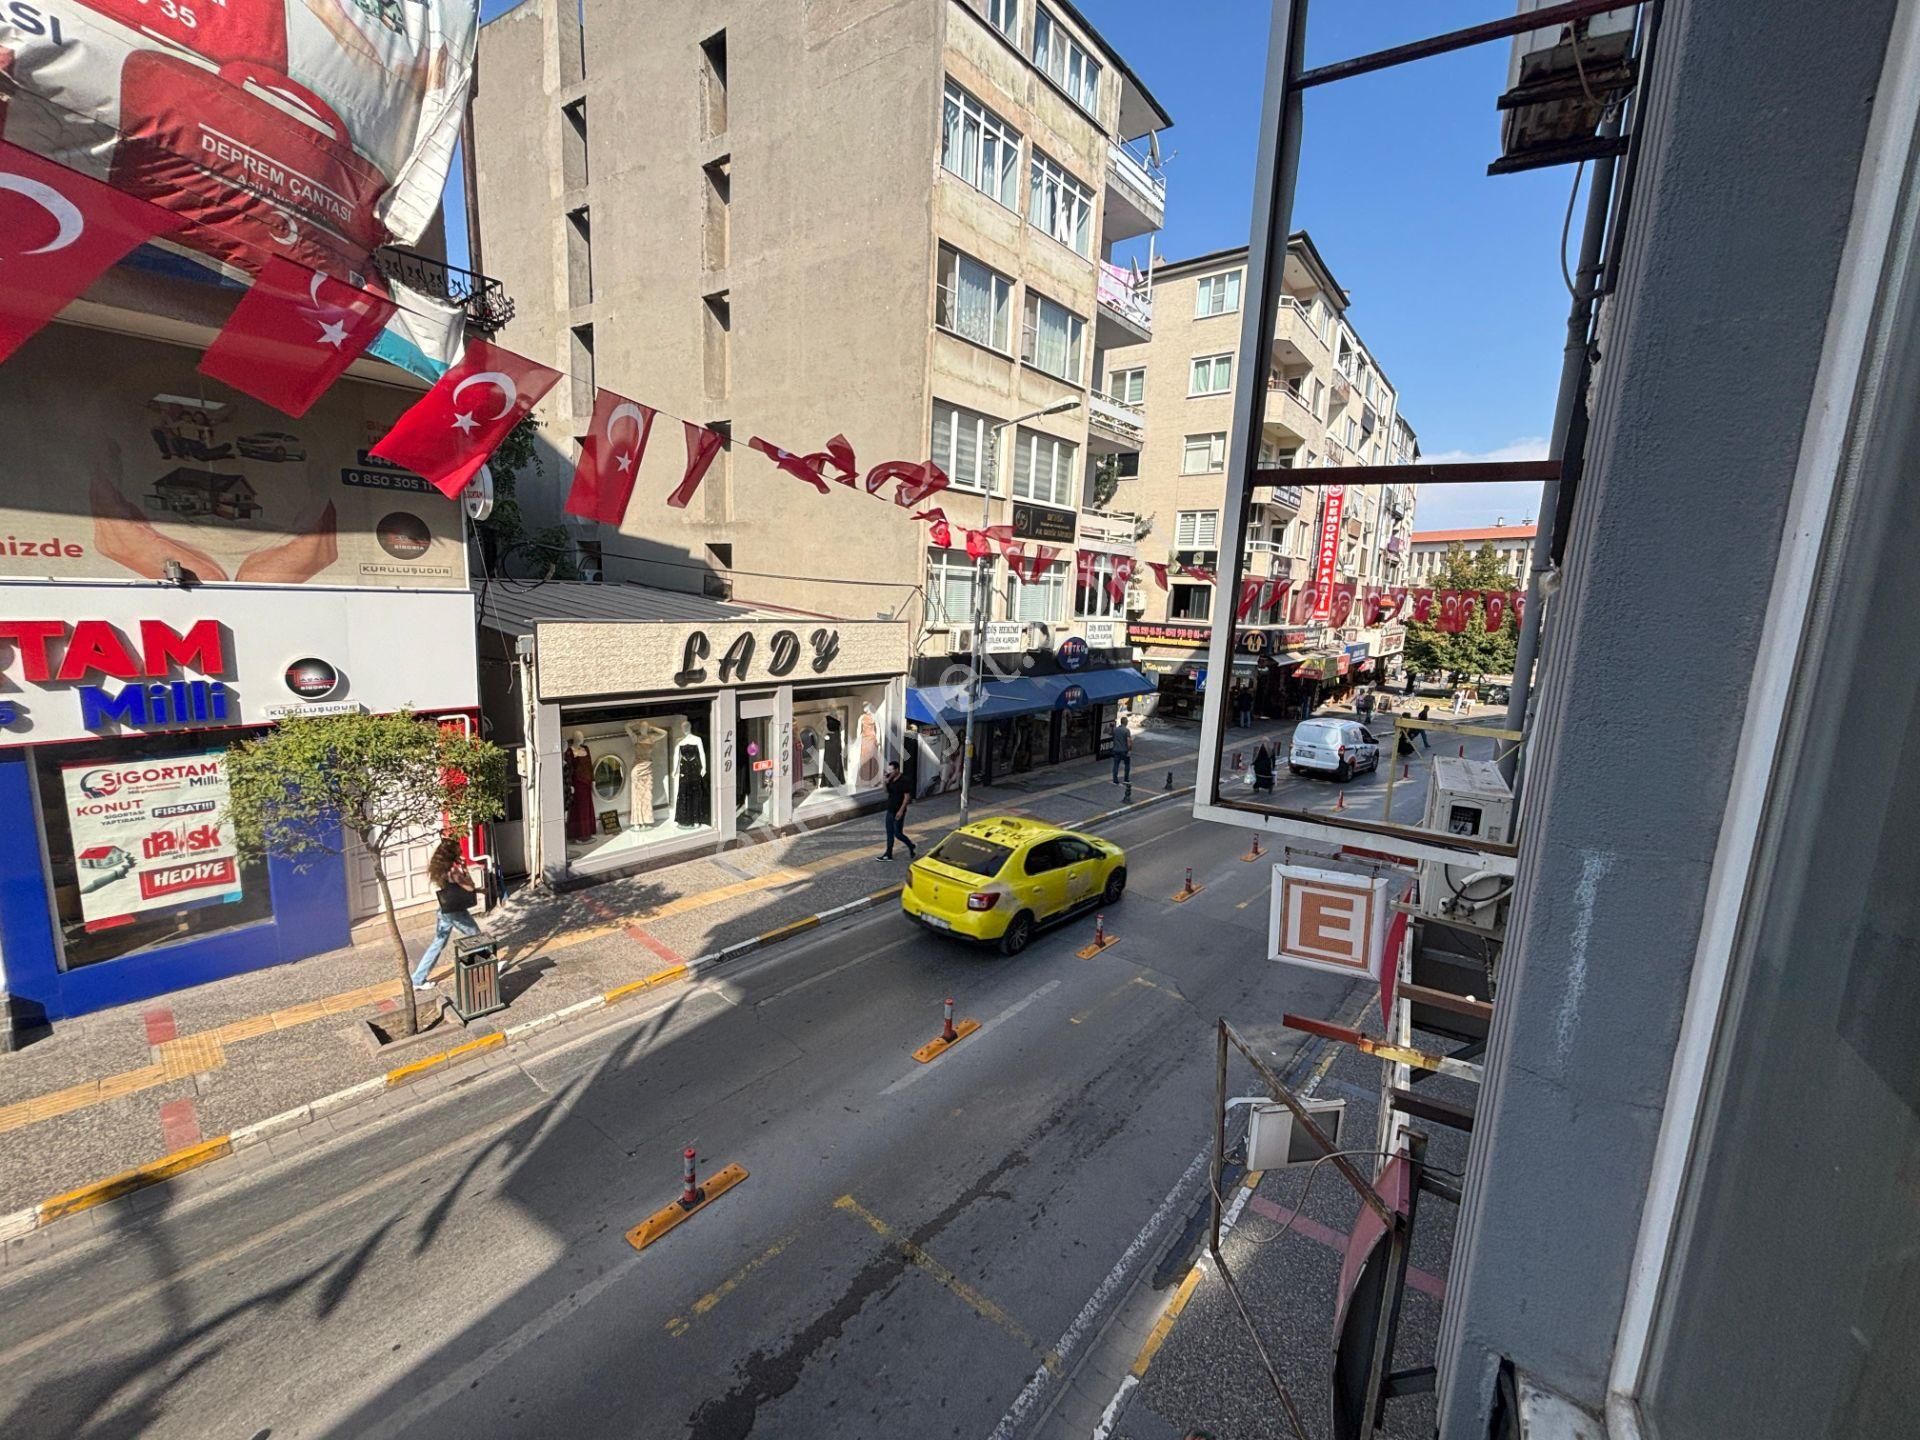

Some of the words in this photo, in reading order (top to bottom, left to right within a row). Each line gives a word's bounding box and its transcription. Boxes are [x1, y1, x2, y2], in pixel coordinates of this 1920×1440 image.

[201, 134, 285, 187] DEPREM
[289, 178, 351, 222] ÇANTASI
[349, 472, 360, 483] 0
[363, 473, 390, 487] 850
[393, 477, 419, 490] 305
[1322, 499, 1340, 565] DEMOKRAT
[362, 565, 450, 576] KURULUŞUDUR
[674, 628, 840, 688] LADY
[79, 680, 227, 731] Milli
[782, 722, 790, 777] LADY
[76, 799, 144, 817] KONUT
[153, 861, 226, 887] HEDİYE
